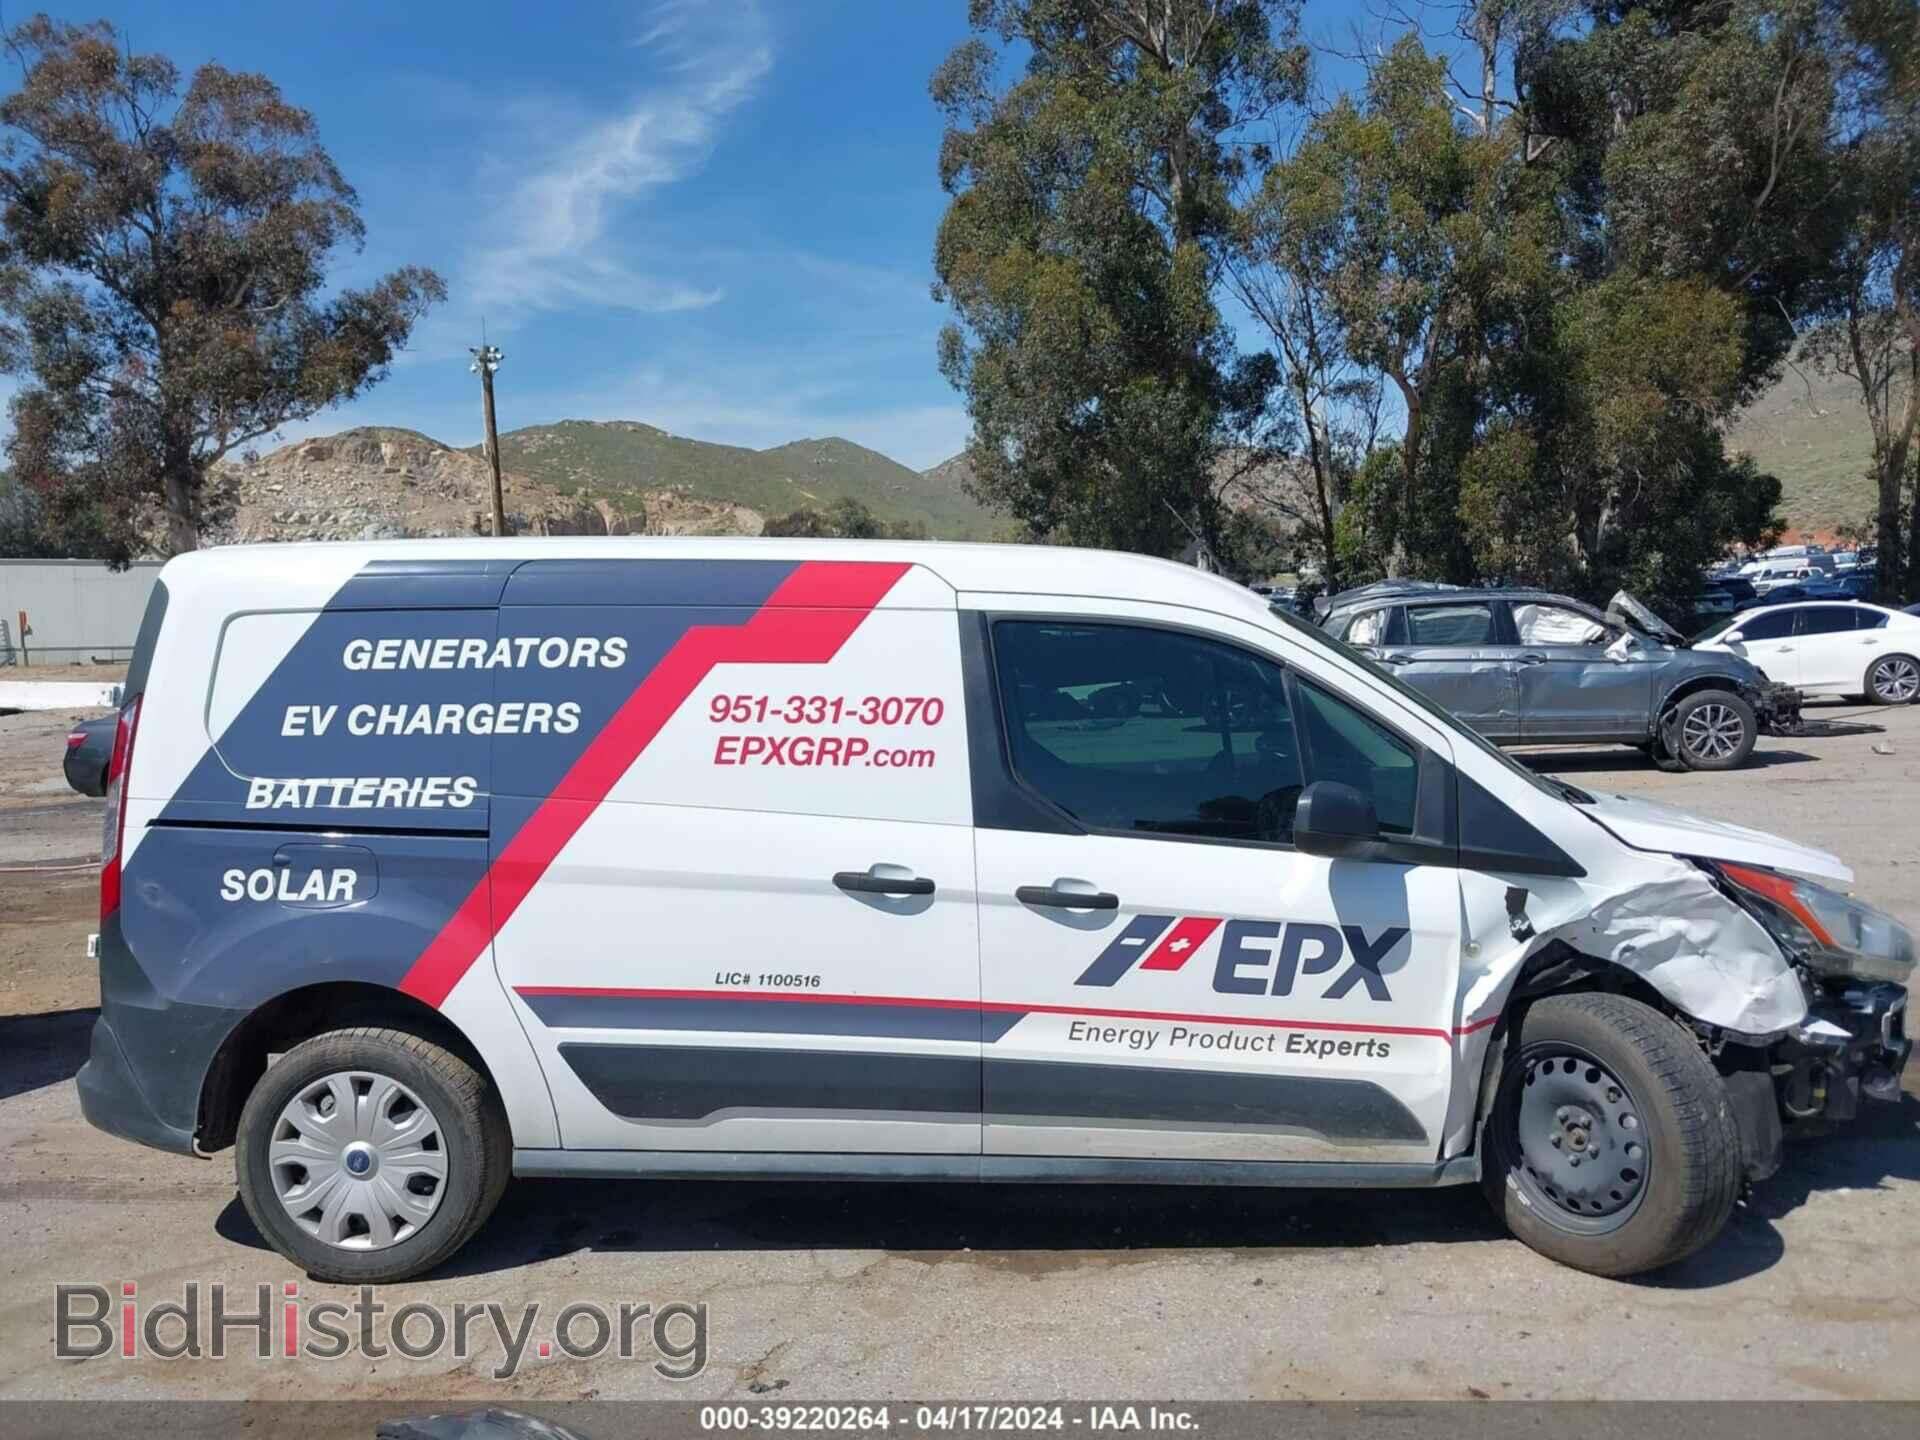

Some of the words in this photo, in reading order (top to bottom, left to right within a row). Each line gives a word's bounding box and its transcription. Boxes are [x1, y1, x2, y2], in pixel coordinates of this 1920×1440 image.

[343, 637, 628, 669] GENERATORS
[281, 705, 337, 736] EV
[347, 703, 581, 735] CHARGERS
[709, 695, 944, 725] 951-331-3070
[713, 736, 935, 767] EPXGRP.com
[245, 776, 478, 809] BATTERIES
[220, 868, 358, 903] SOLAR
[1212, 919, 1411, 1002] EPX
[715, 972, 751, 985] LIC#
[759, 974, 821, 987] 1100516
[1068, 1021, 1160, 1050] Energy
[1169, 1027, 1276, 1053] Product
[1285, 1034, 1391, 1059] Experts
